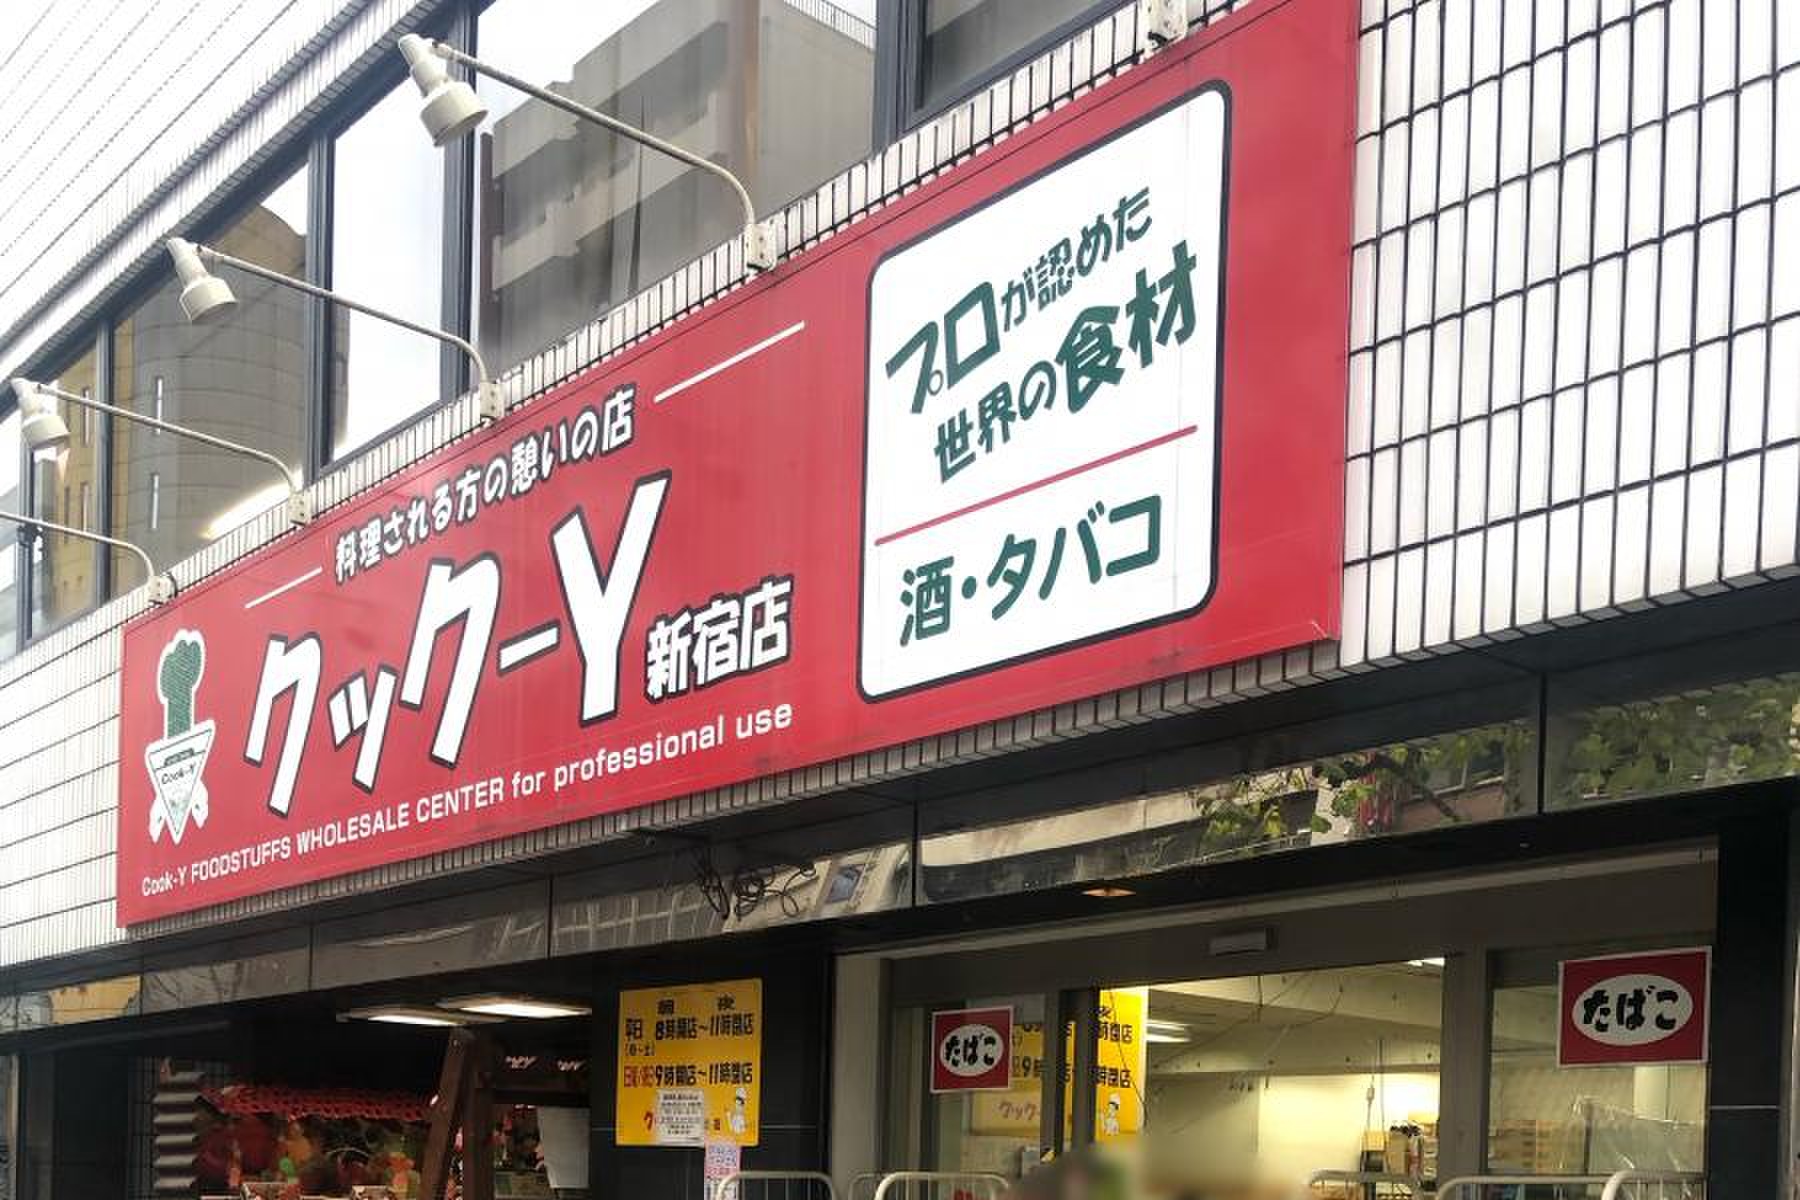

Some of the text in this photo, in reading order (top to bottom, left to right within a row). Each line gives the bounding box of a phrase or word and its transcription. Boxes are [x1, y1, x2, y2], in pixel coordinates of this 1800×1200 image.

[884, 187, 1152, 414] プロが認めた
[934, 239, 1197, 483] 世界の食材
[334, 384, 636, 583] 料理される方の憩いの店
[900, 494, 1162, 646] 酒・タバコ
[644, 574, 795, 703] 新宿店
[141, 703, 794, 898] Cook-Y FOODSTUFFS WHOLESALE CENTER for professional use
[945, 1033, 997, 1068] たばこ
[1583, 985, 1680, 1033] たばこ
